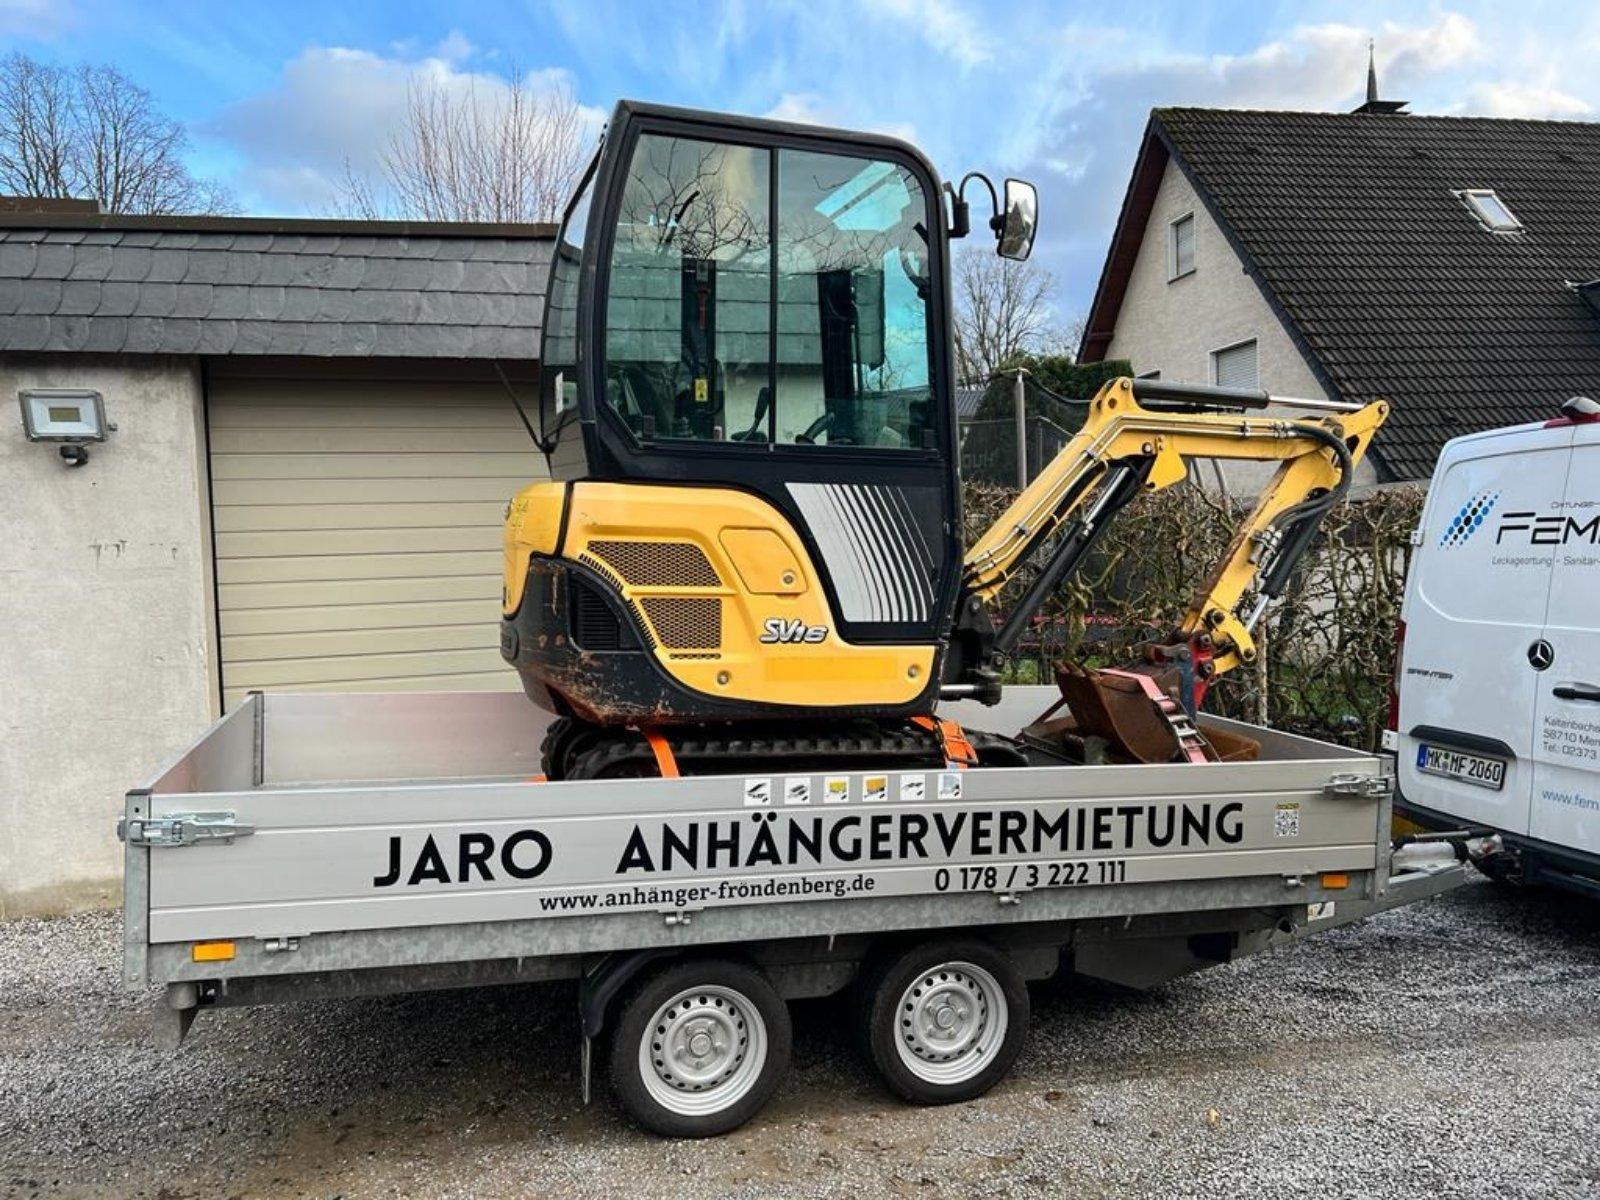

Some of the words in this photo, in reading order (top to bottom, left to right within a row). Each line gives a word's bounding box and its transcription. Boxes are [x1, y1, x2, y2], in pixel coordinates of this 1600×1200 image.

[1496, 512, 1600, 545] FEM
[759, 619, 828, 643] SV16
[1543, 729, 1577, 742] 58710
[1450, 753, 1467, 773] MF
[1468, 759, 1501, 782] 2060
[1562, 745, 1597, 760] 02373
[374, 829, 553, 887] JARO
[616, 802, 1244, 874] ANHÄNGERVERMIETUNG
[935, 868, 950, 891] 0
[960, 866, 998, 890] 178
[1006, 865, 1019, 889] /
[1026, 864, 1040, 887] 3
[1048, 862, 1090, 886] 222
[1099, 859, 1126, 883] 111
[539, 874, 875, 910] www.anhänger-fröndenberg.de
